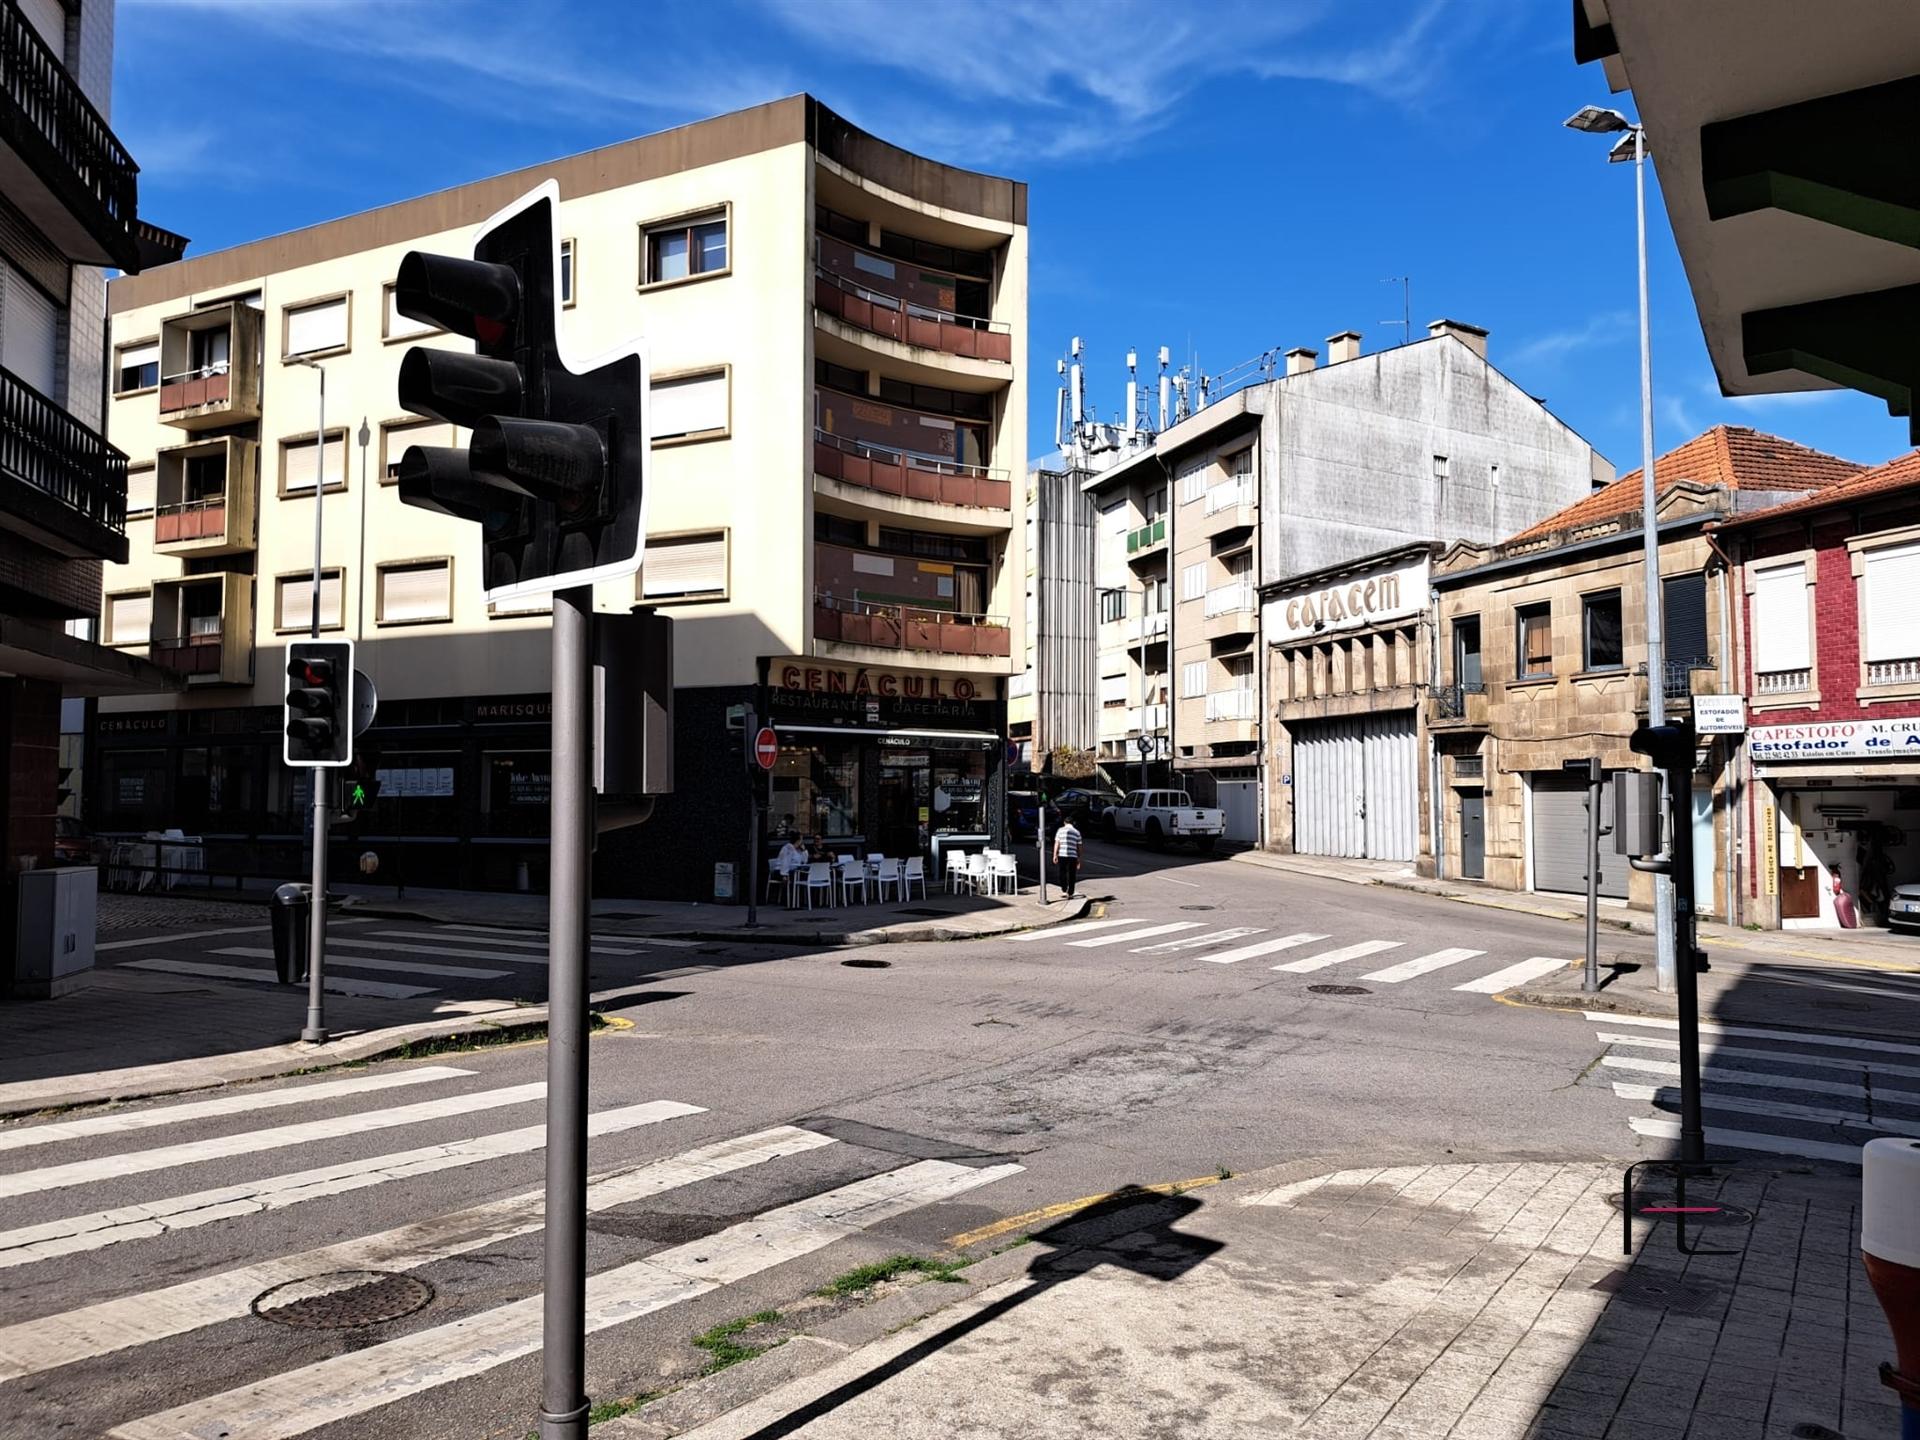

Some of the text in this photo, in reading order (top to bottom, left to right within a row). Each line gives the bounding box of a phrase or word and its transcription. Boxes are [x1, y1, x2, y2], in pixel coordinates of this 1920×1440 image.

[783, 667, 975, 699] CENÁCULO
[1752, 724, 1855, 741] CAPESTOFO
[1871, 725, 1888, 734] M.
[1752, 739, 1849, 752] Estofador
[1865, 737, 1891, 747] de
